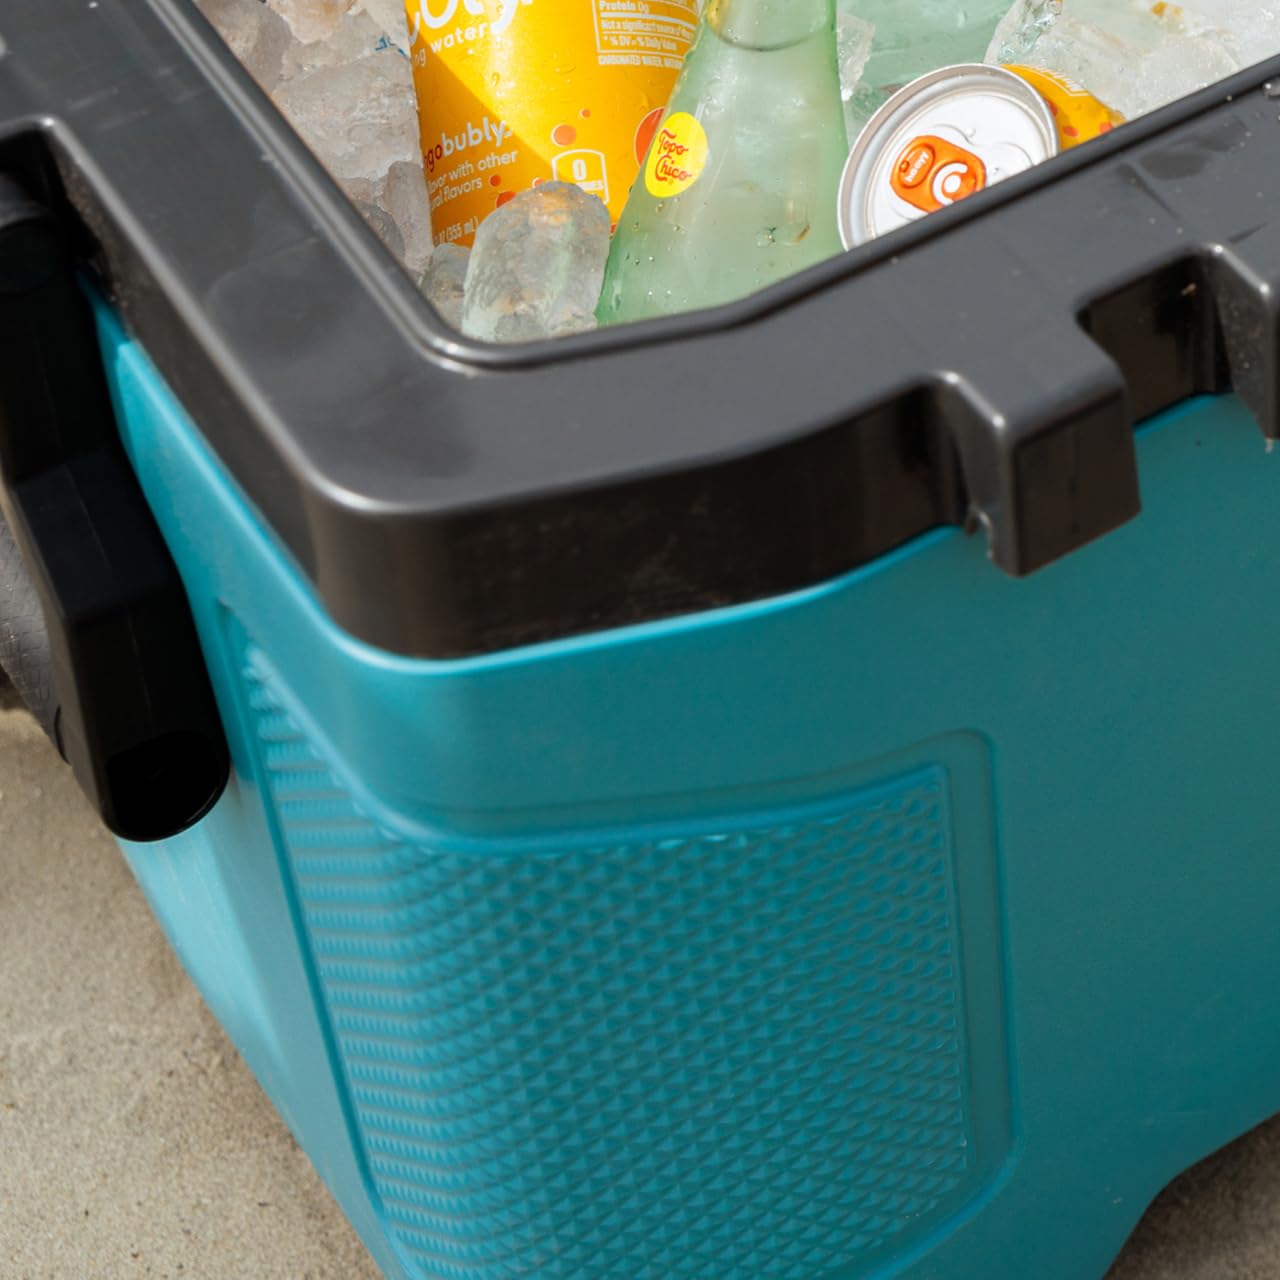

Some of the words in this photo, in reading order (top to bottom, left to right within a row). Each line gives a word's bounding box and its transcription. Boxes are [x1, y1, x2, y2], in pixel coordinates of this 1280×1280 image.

[600, 0, 637, 11] Protein
[429, 22, 487, 54] water
[657, 128, 689, 155] Topo
[448, 160, 474, 181] with
[477, 150, 519, 171] other
[572, 158, 588, 181] 0
[654, 153, 694, 182] Chico
[444, 177, 483, 202] flavors
